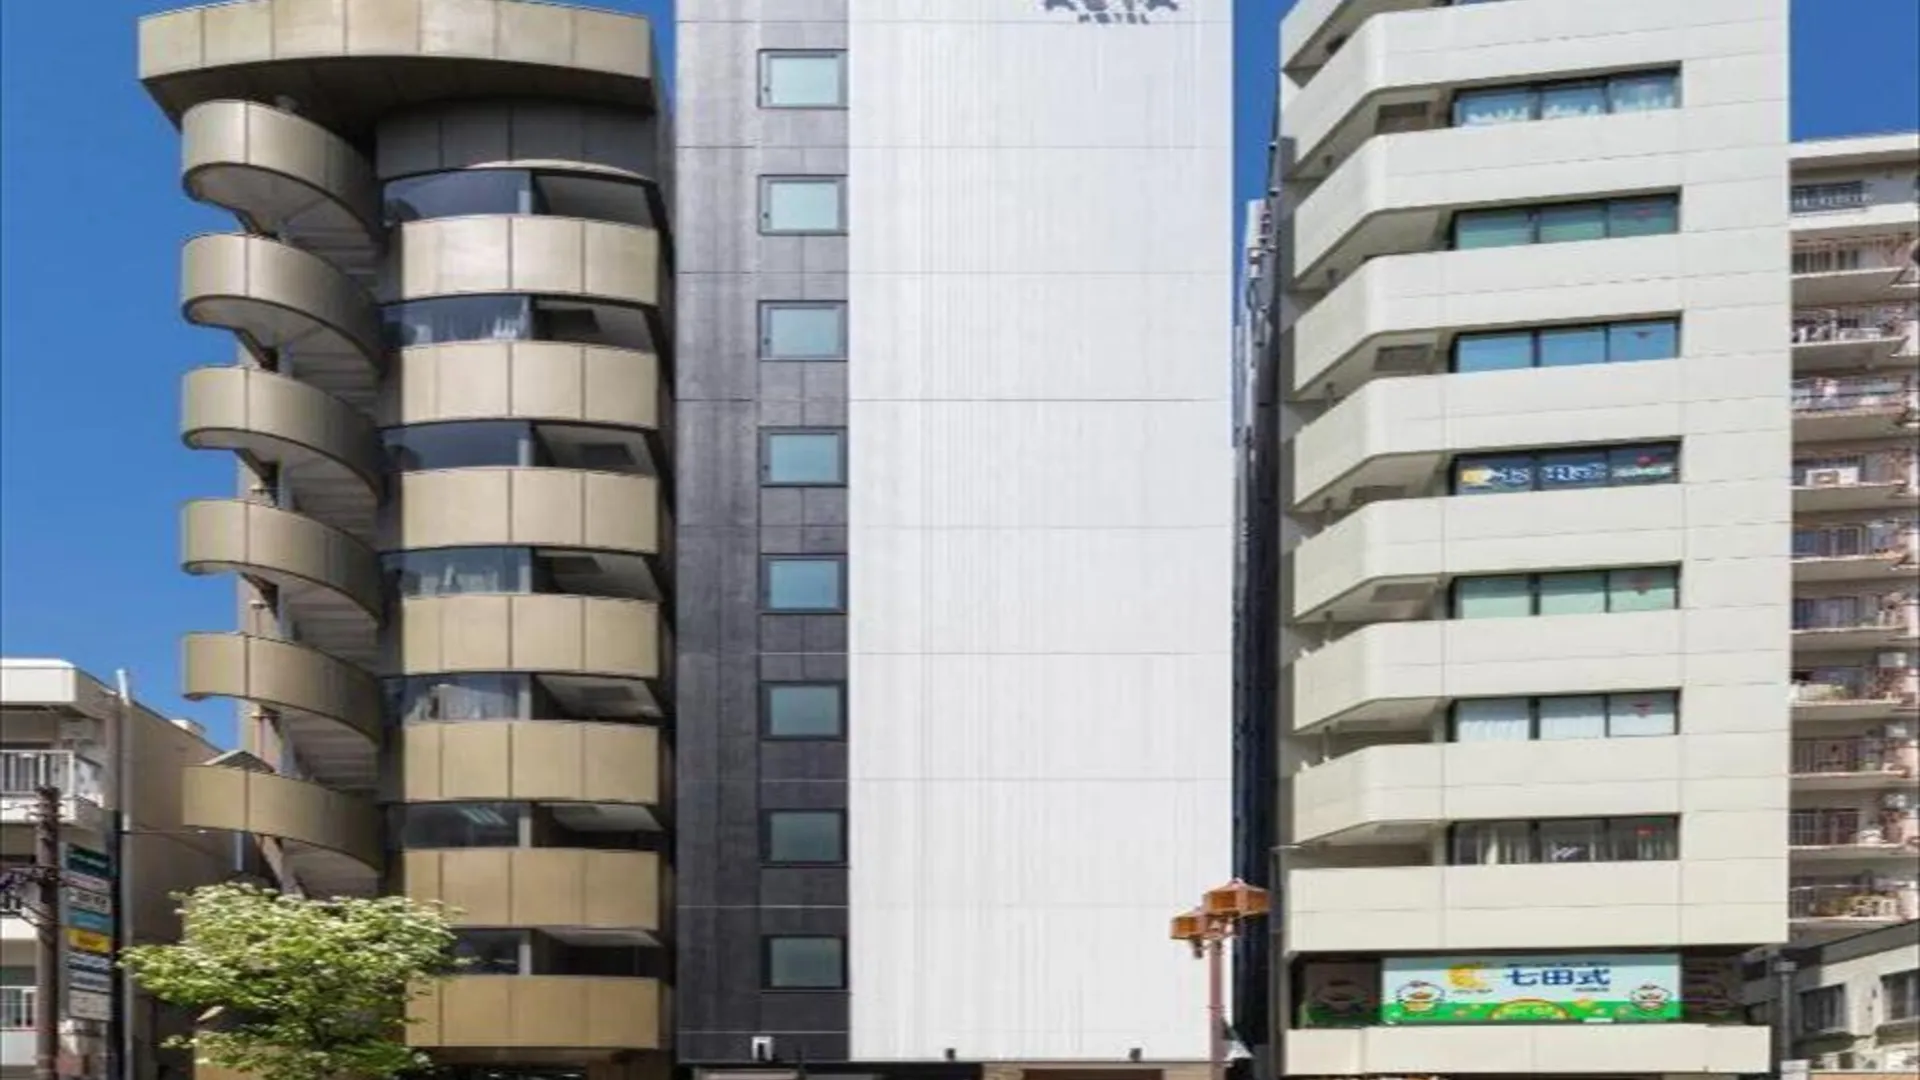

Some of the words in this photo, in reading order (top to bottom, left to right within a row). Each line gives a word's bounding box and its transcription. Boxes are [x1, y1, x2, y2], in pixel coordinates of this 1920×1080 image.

[1078, 12, 1150, 24] HOTEL
[1505, 968, 1611, 986] 七田式
